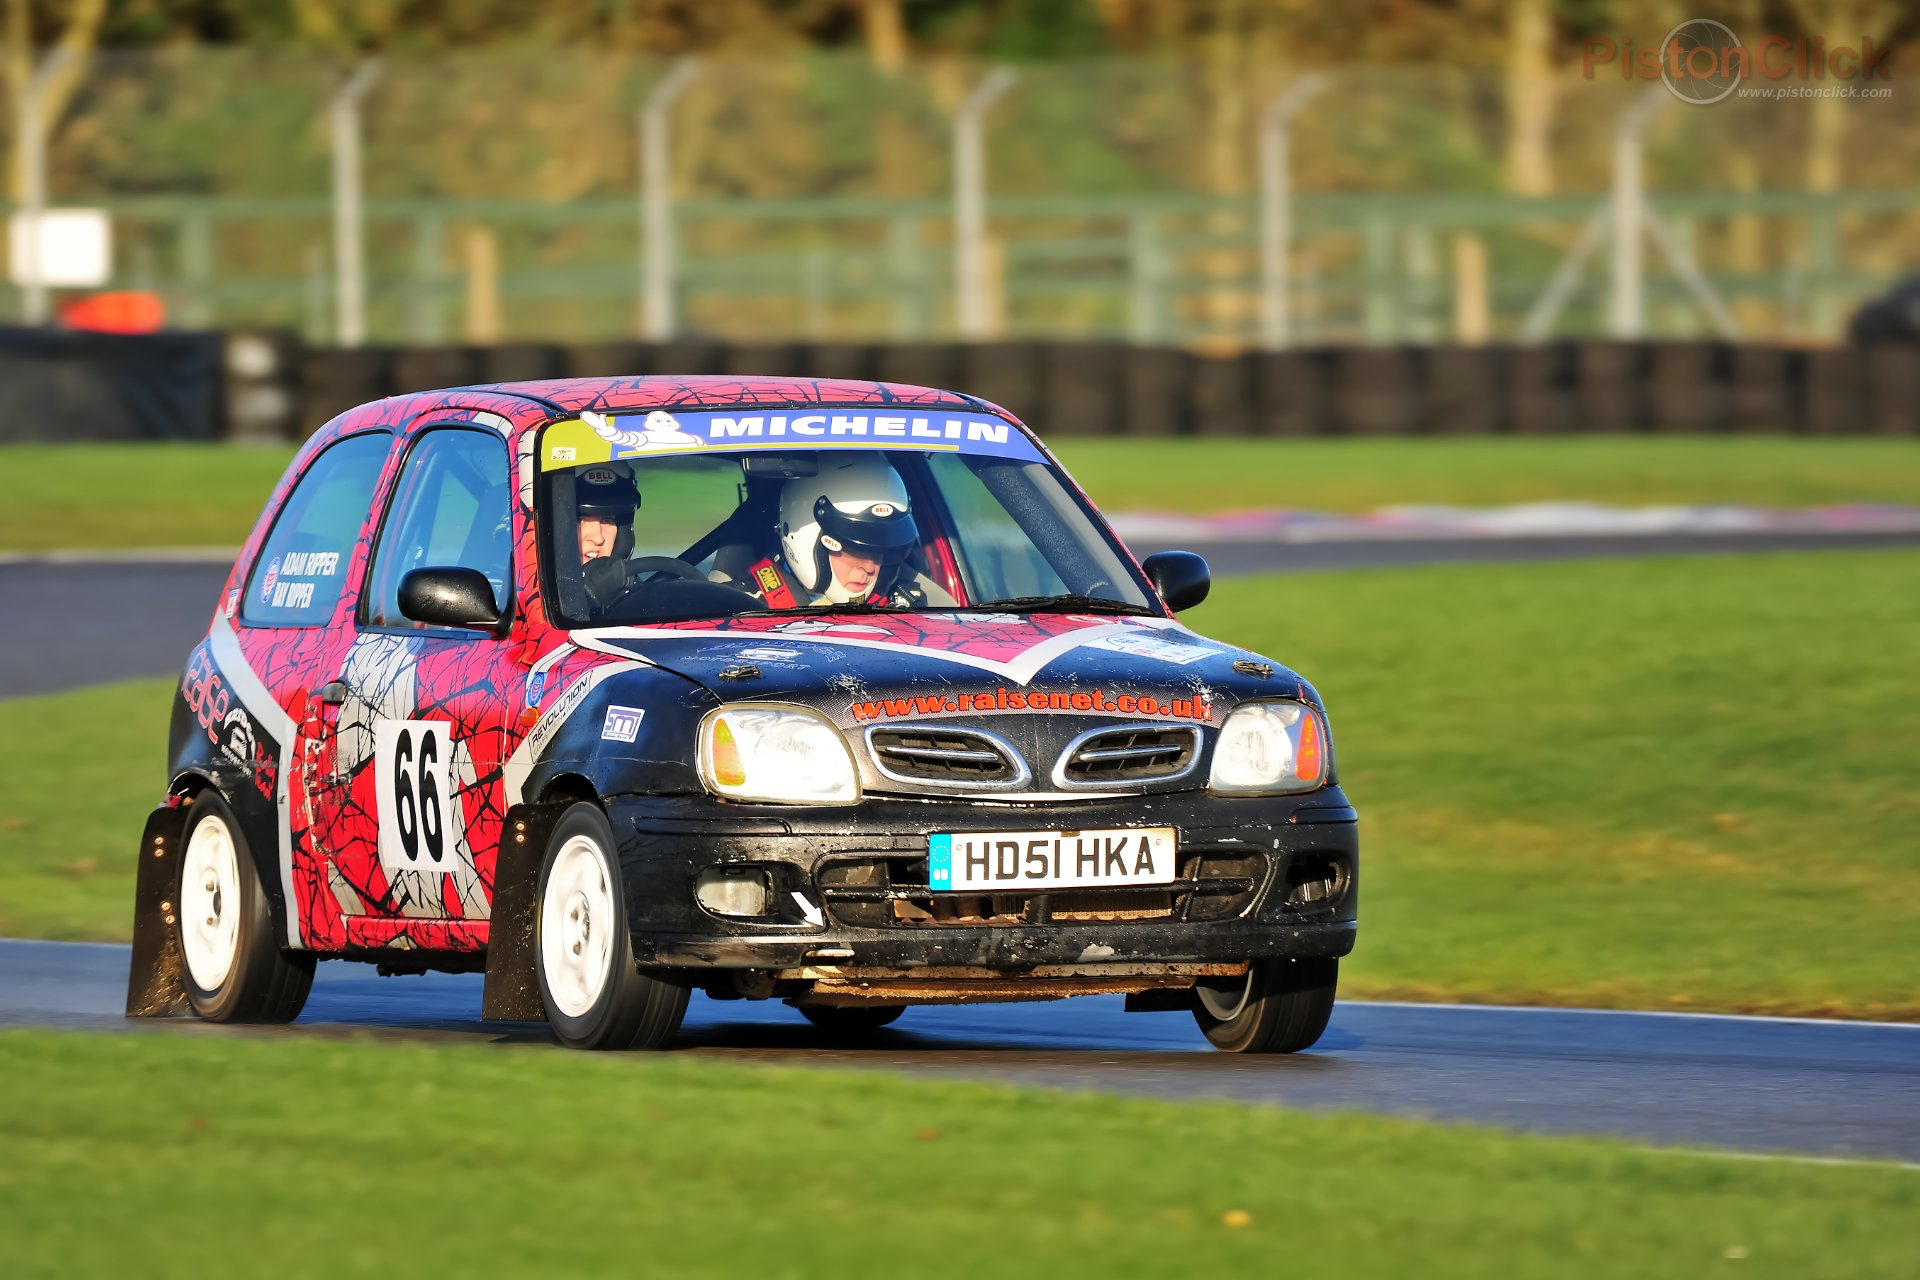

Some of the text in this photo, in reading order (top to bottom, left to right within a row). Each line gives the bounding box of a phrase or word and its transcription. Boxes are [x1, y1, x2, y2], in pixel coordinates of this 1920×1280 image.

[709, 416, 1009, 443] MICHELIN
[588, 472, 613, 480] BELL
[824, 537, 838, 549] BELL
[280, 552, 340, 576] ADAM RIPPER
[760, 567, 778, 590] OMP
[532, 676, 588, 747] REVOLUTION
[851, 687, 1214, 721] www.raisenet.co.uk
[394, 728, 444, 863] 66
[965, 836, 1155, 881] HD51 HKA
